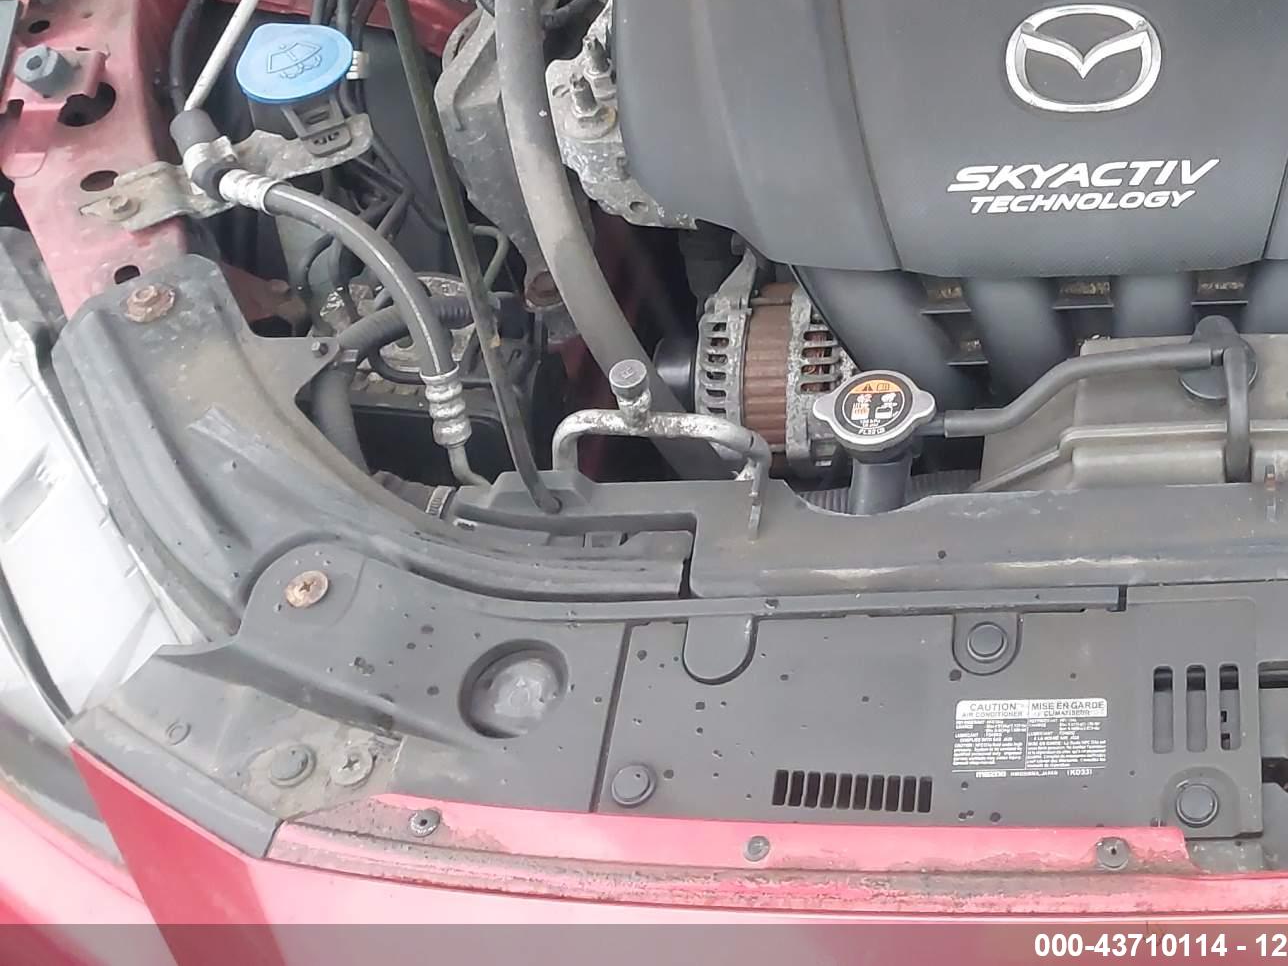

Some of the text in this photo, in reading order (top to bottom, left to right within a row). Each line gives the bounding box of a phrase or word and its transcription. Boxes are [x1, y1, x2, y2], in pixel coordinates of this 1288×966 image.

[947, 159, 1220, 192] SKYACTIV
[970, 190, 1195, 214] TECHNOLOGY
[970, 703, 1017, 712] CAUTION
[1031, 701, 1105, 711] MISE EN GARDE
